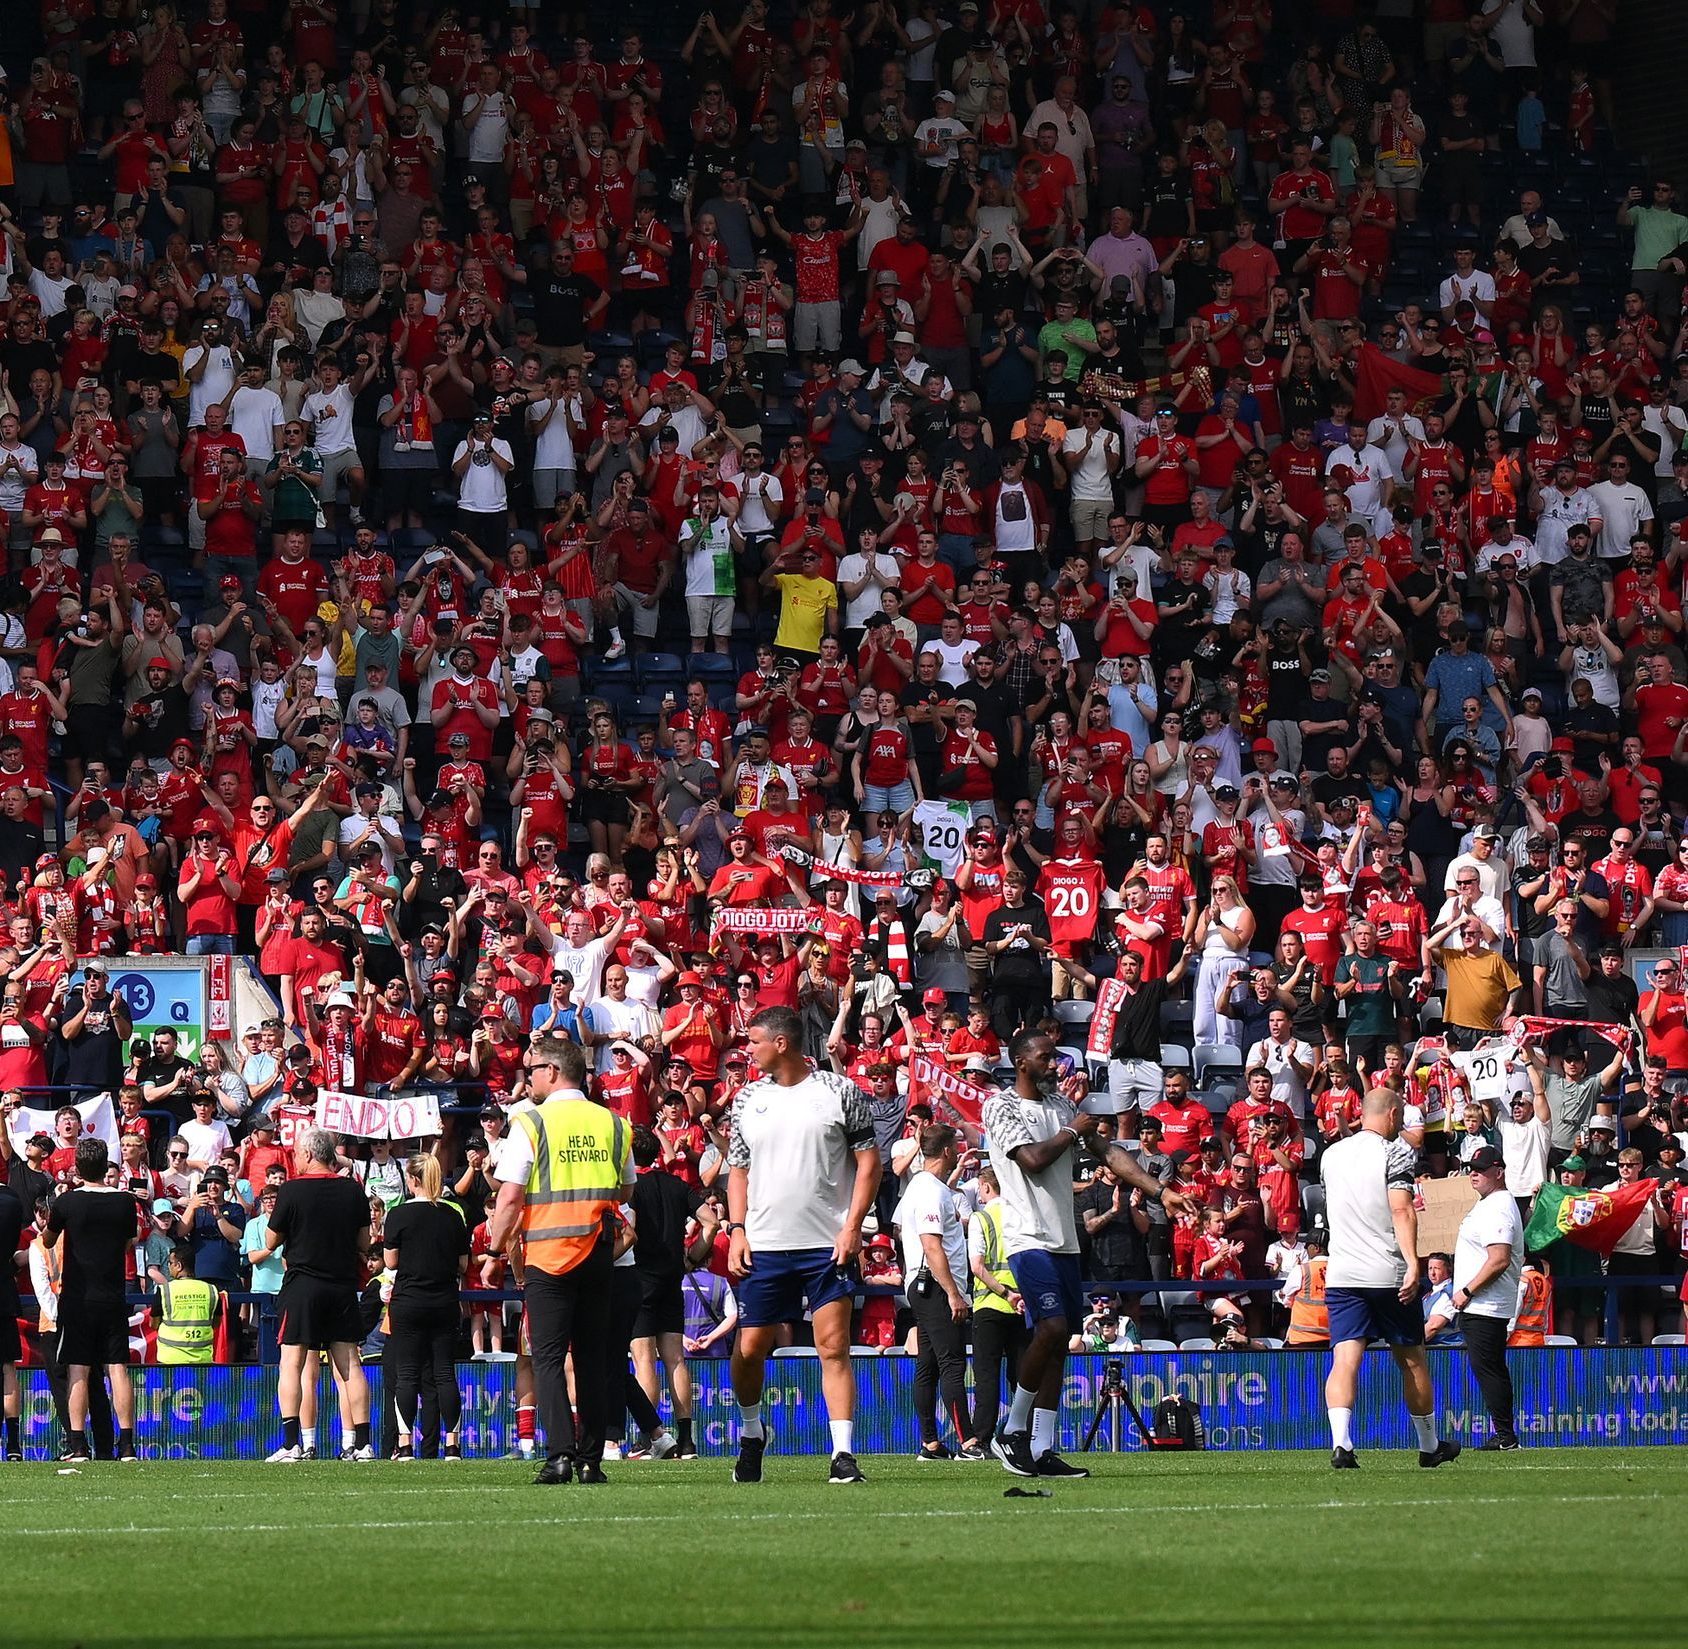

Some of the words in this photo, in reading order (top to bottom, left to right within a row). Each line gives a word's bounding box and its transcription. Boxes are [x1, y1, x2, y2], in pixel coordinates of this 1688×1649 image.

[550, 283, 579, 296] BOSS
[1271, 659, 1300, 670] BOSS
[873, 745, 896, 759] AXA
[928, 825, 960, 849] 20
[814, 856, 859, 876] DIOGO
[862, 867, 900, 880] JOTA
[1053, 877, 1078, 886] DIOGO
[1050, 887, 1090, 918] 20
[719, 912, 765, 928] DIOGO
[767, 911, 809, 928] JOTA
[119, 980, 150, 1007] 13
[169, 1001, 189, 1023] Q
[914, 1055, 987, 1102] DIOG
[1472, 1057, 1498, 1082] 20
[324, 1094, 416, 1137] ENDO
[568, 1135, 595, 1148] HEAD
[559, 1148, 609, 1163] STEWARD
[174, 1293, 207, 1301] PRESTIGE
[185, 1329, 202, 1339] 512
[1445, 1404, 1622, 1438] Mataining
